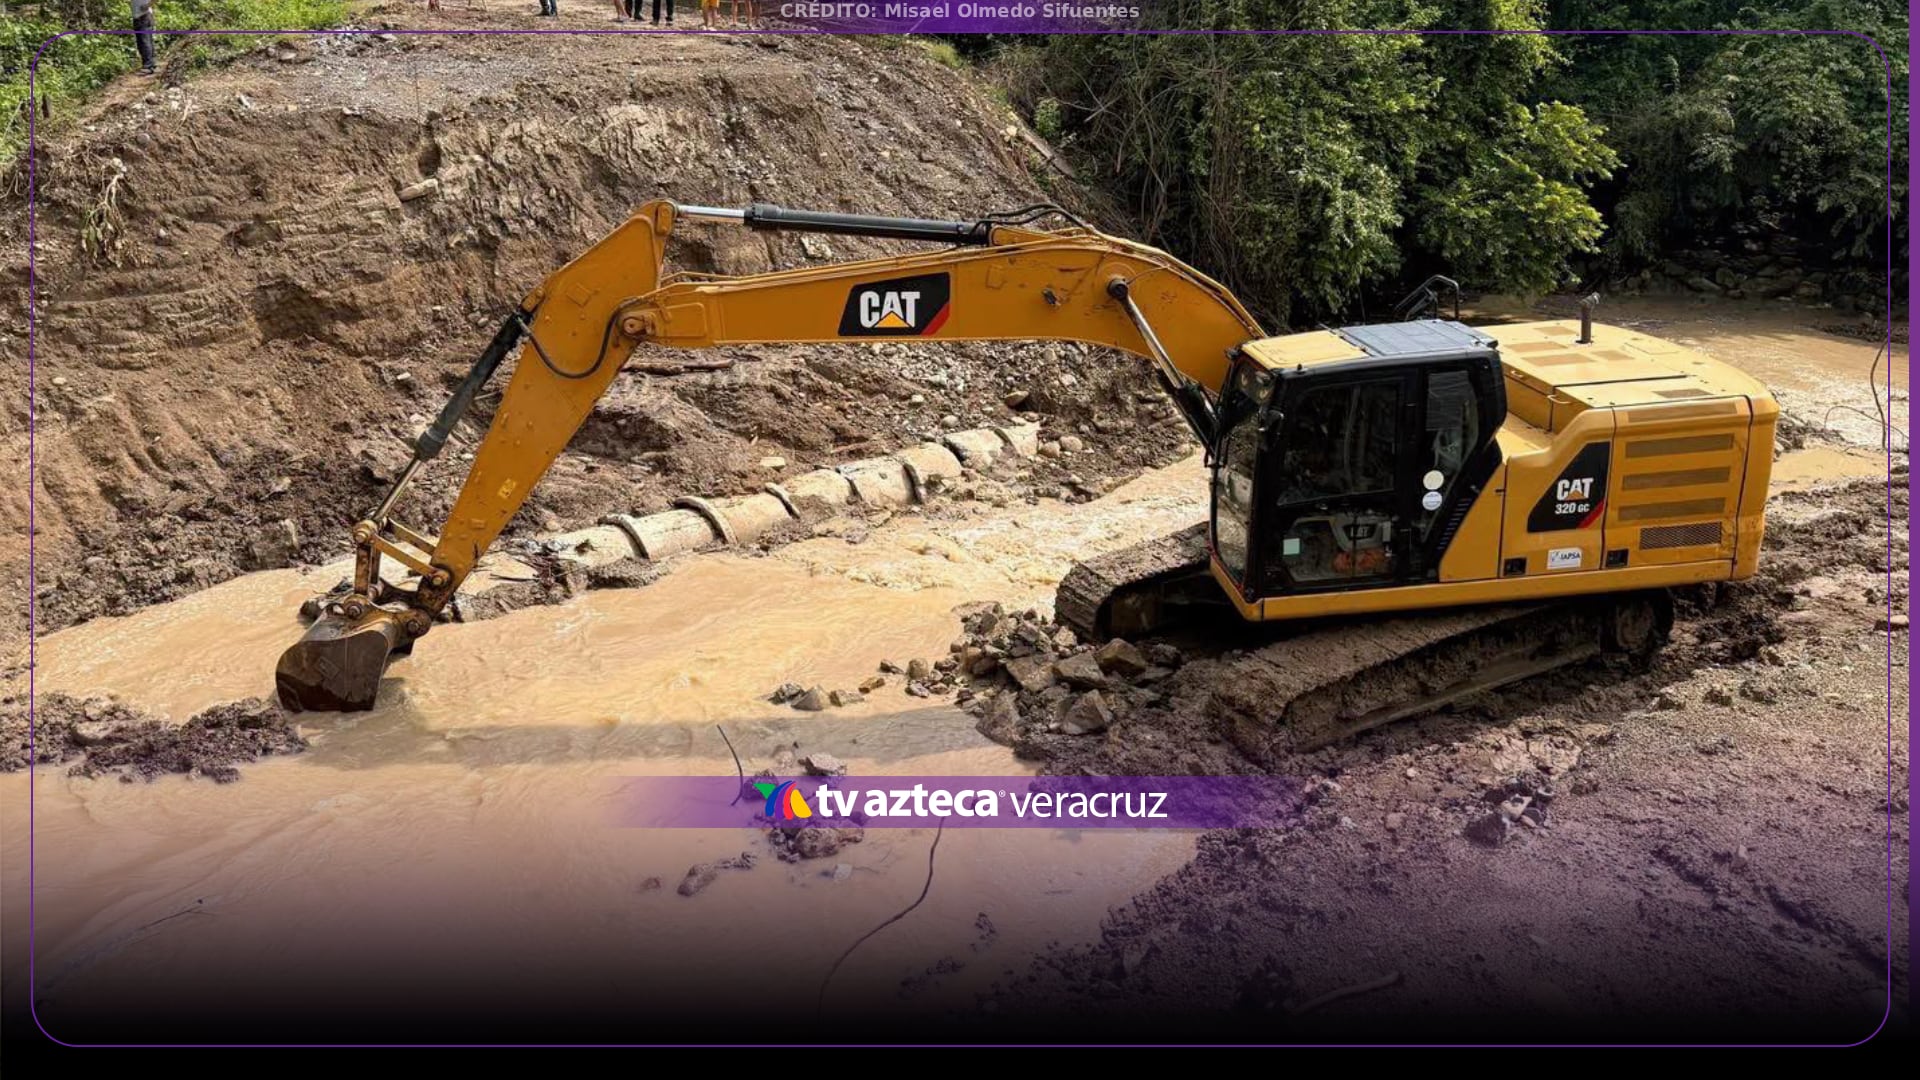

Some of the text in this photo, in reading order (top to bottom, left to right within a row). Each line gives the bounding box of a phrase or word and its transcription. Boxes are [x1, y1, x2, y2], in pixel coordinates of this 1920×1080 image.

[860, 290, 920, 328] CAT
[1557, 478, 1594, 500] CAT
[1555, 503, 1590, 514] 320 GC
